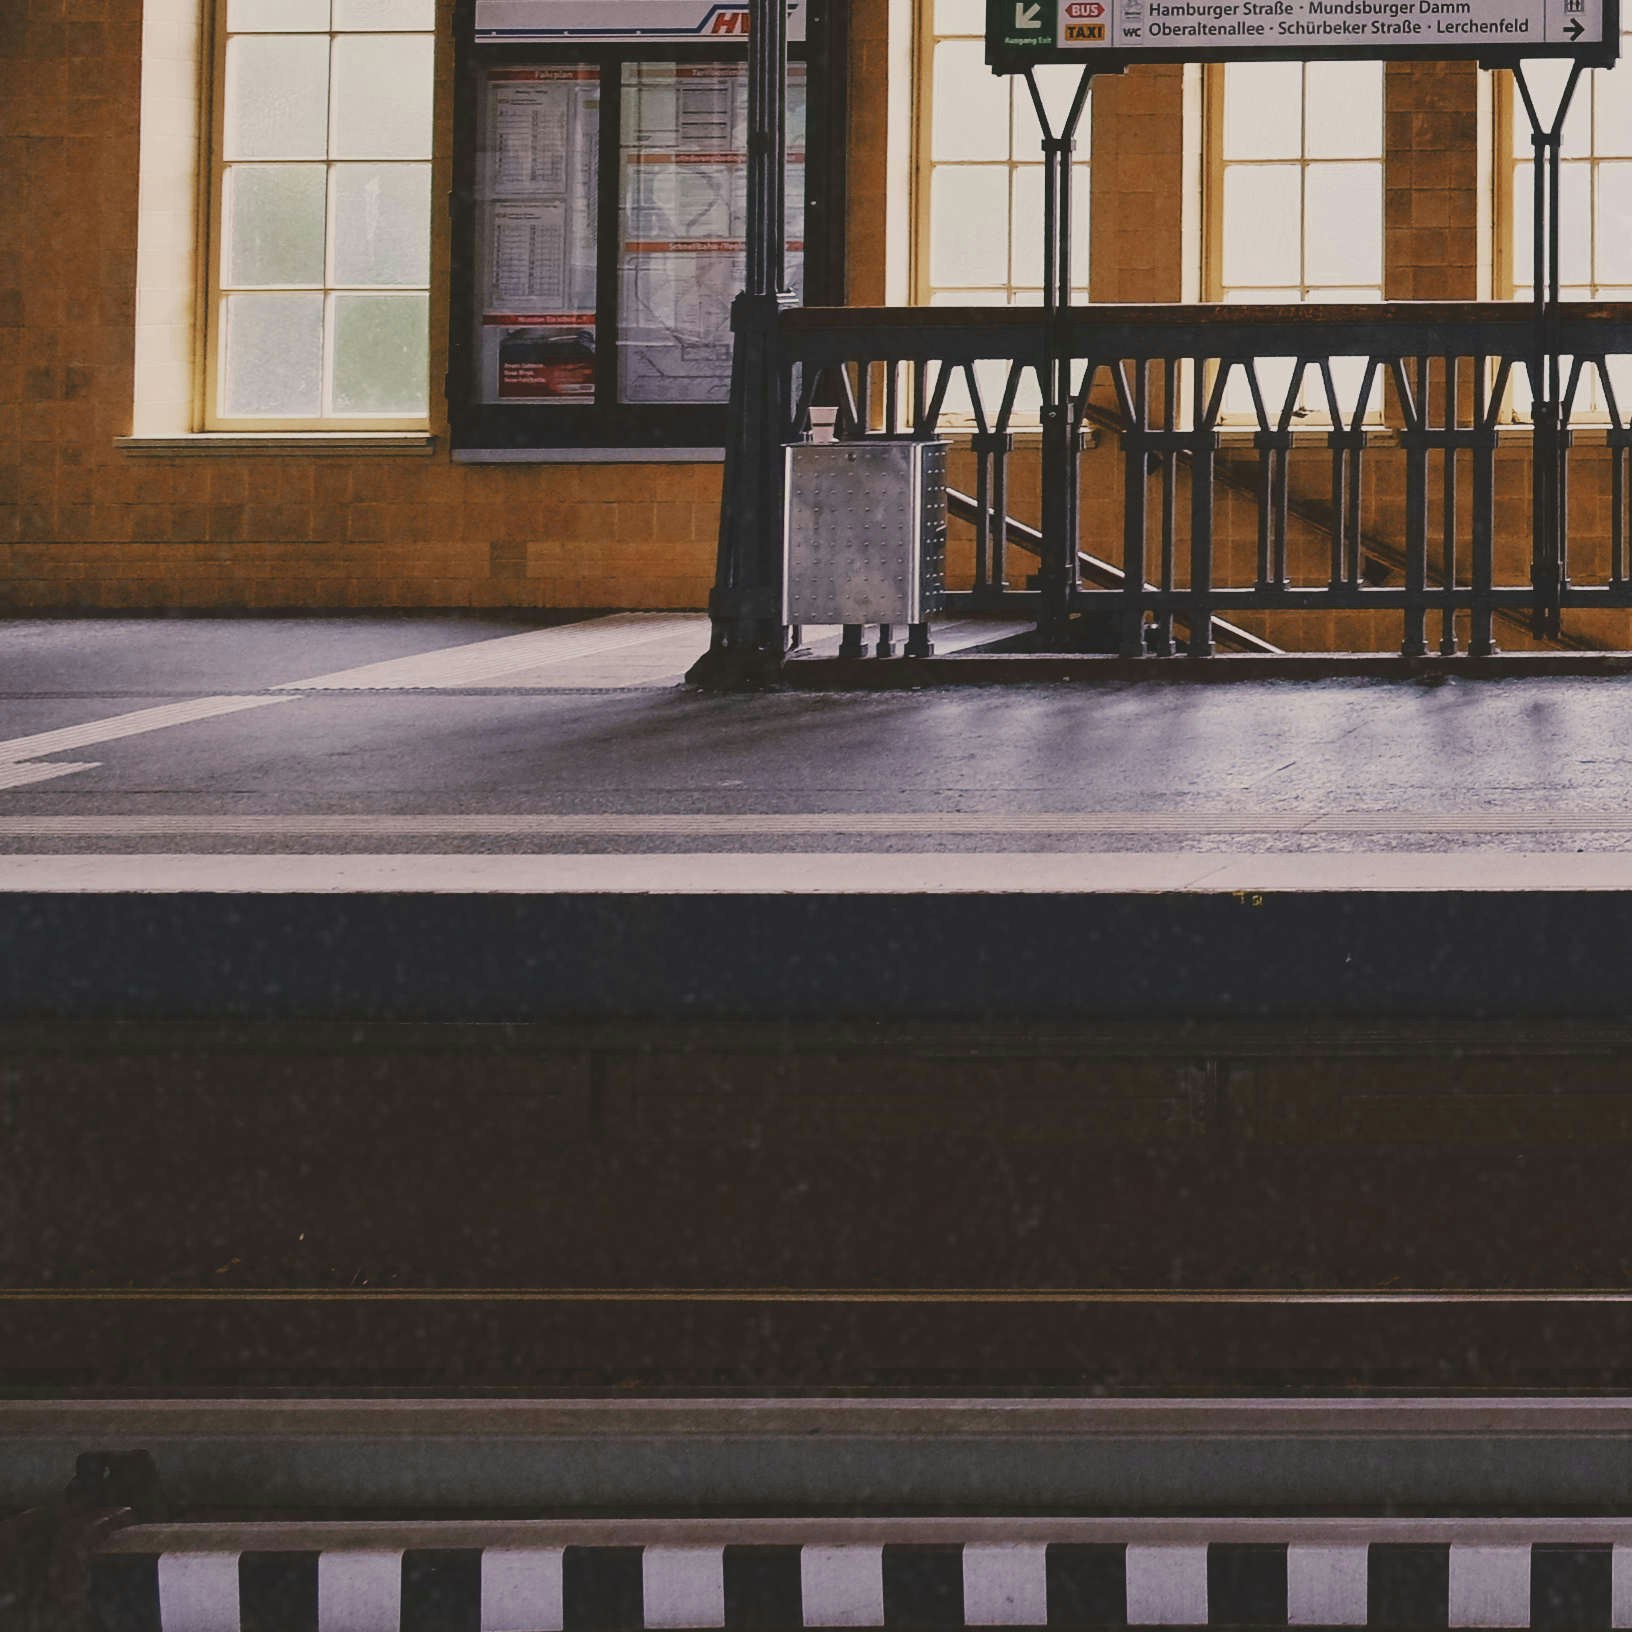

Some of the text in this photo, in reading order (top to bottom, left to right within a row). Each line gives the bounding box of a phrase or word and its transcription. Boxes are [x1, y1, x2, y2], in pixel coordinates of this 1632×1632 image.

[1071, 4, 1099, 17] BUS
[1149, 0, 1471, 19] Hamburger Straße Mundsburger Damm
[1066, 25, 1103, 38] TAXI
[1149, 18, 1529, 36] Oberaltenallee Schürbeker Straße Lerchenfeld
